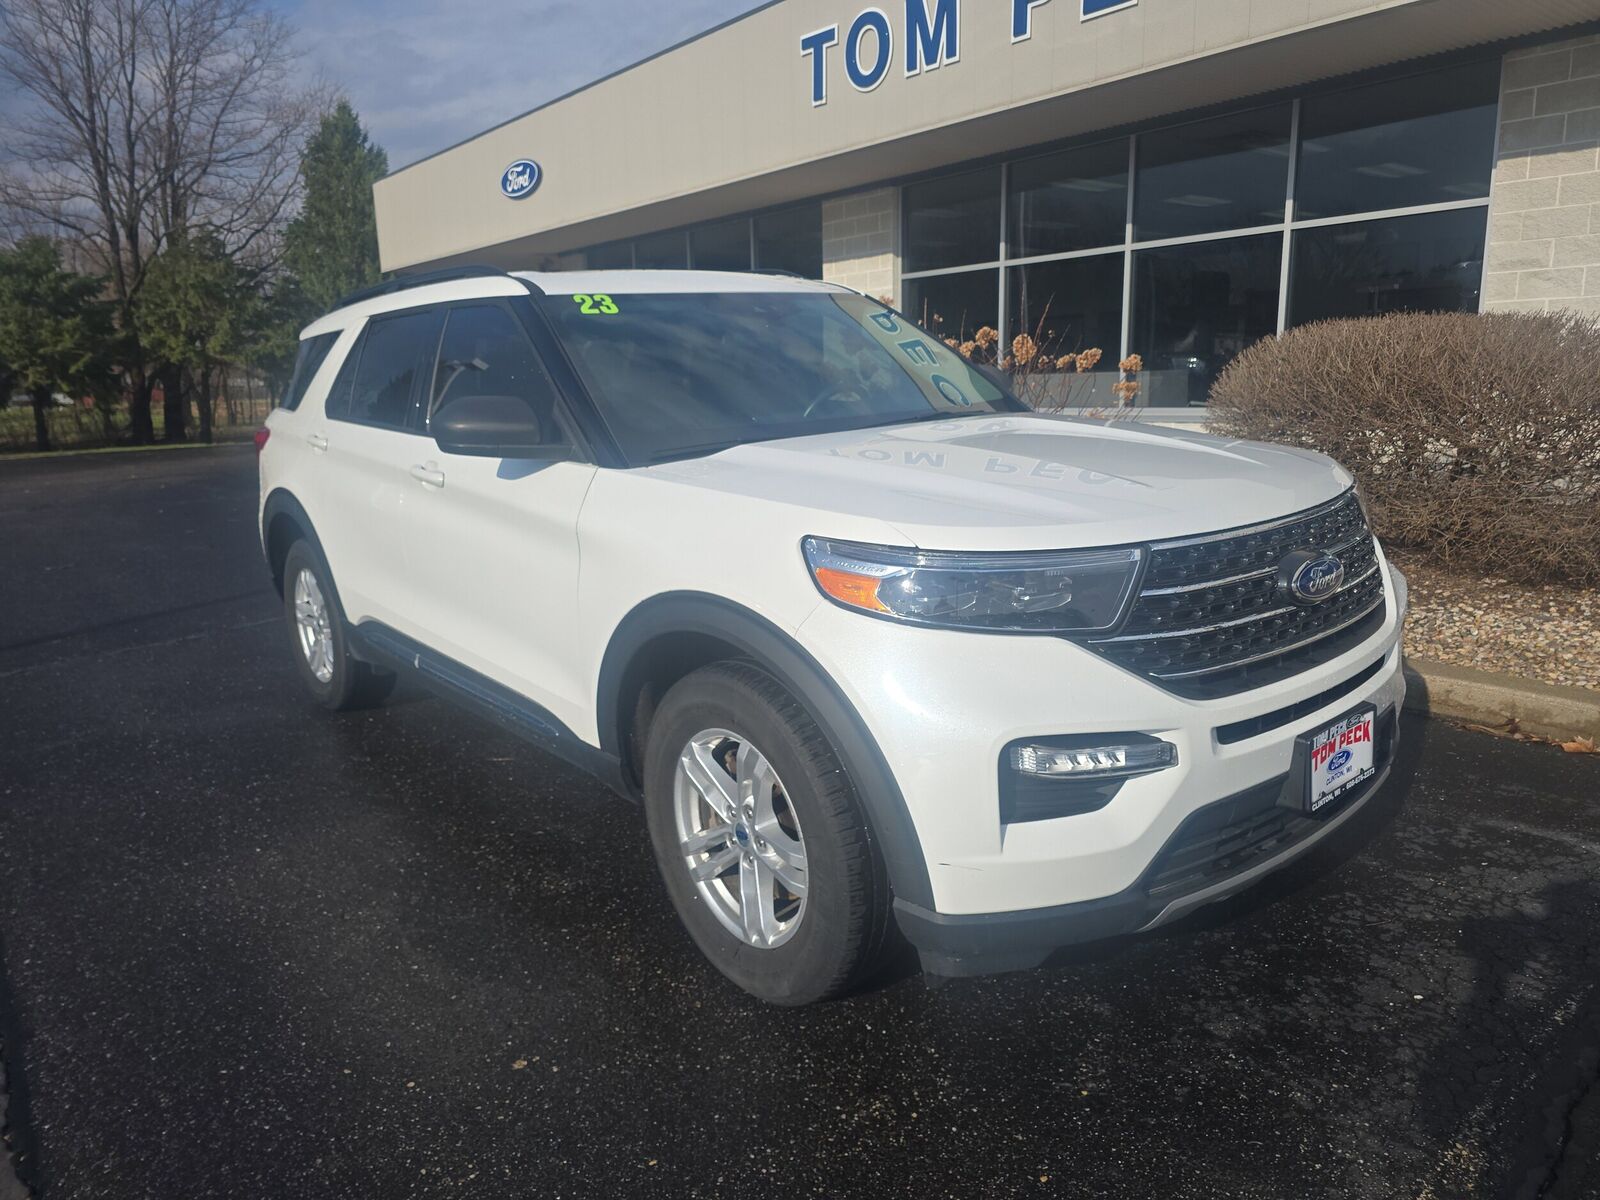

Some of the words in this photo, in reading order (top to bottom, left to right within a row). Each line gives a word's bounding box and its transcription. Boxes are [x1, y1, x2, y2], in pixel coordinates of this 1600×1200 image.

[801, 0, 960, 107] TOM
[506, 164, 531, 192] Ford
[573, 294, 619, 314] 23
[1310, 562, 1337, 592] Ford
[1312, 737, 1336, 772] TOM
[1339, 719, 1371, 749] PECK
